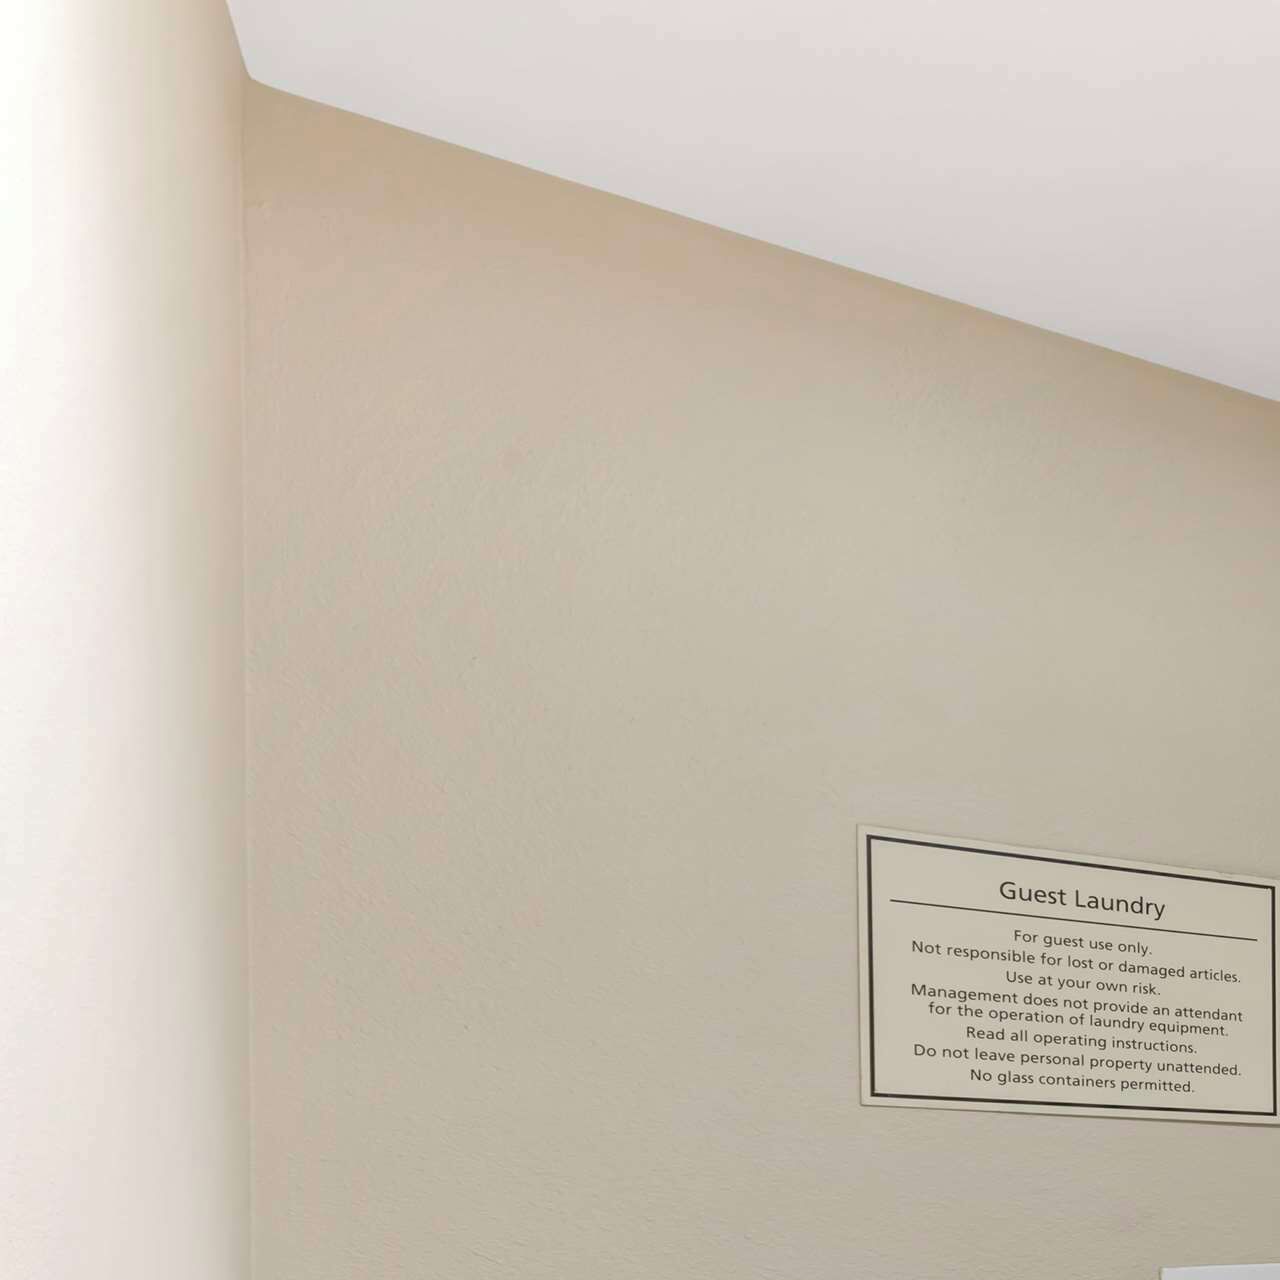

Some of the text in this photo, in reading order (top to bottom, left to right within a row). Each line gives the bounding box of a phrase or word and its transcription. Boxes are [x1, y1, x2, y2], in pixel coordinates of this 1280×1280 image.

[999, 881, 1166, 921] Guest Laundry
[1014, 929, 1153, 958] For guest use only.
[911, 940, 1241, 983] Not responsible for lost or damaged articles.
[1006, 970, 1161, 996] Use at your own risk.
[911, 983, 1243, 1023] Management does not provide an attendant
[928, 1001, 1229, 1037] for the operation of laundry equipment.
[966, 1026, 1197, 1054] Read all operating instructions.
[914, 1043, 1241, 1076] Do not leave personal property unattended.
[970, 1068, 1195, 1093] No glass containers permitted.
